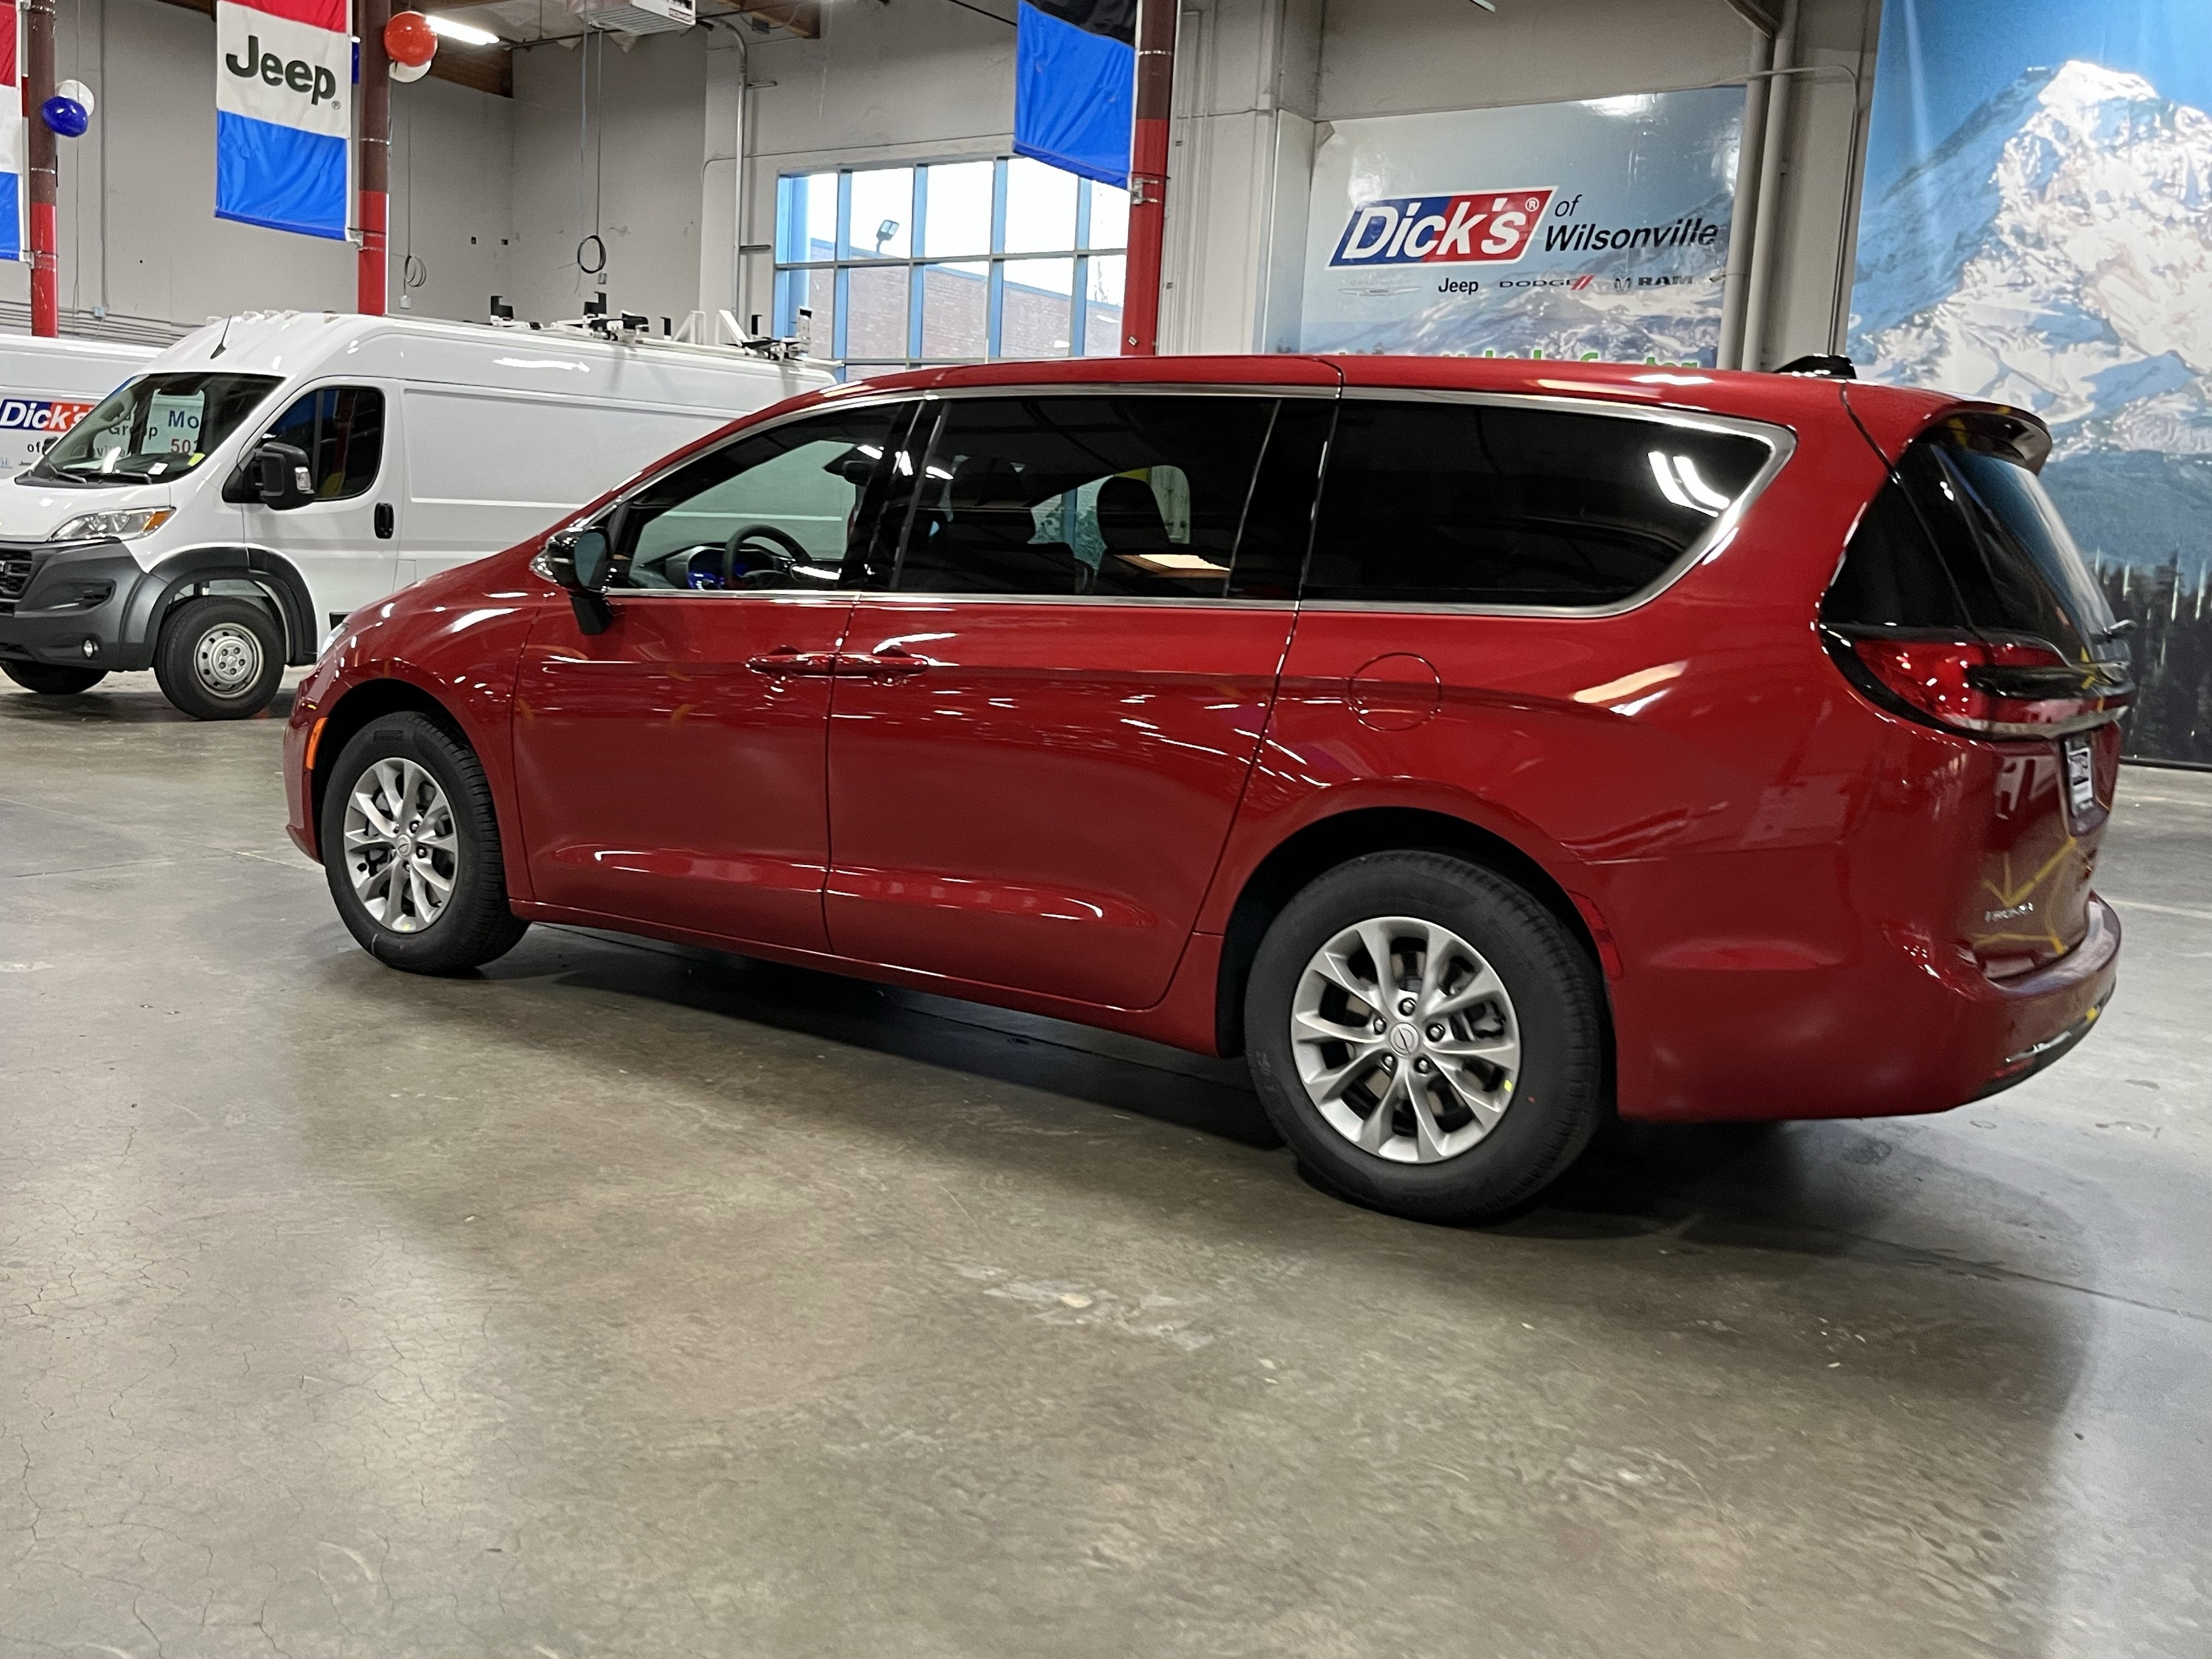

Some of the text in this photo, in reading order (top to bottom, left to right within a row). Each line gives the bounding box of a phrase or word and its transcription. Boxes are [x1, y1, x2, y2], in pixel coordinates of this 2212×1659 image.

[225, 35, 336, 106] Jeep
[1341, 194, 1583, 259] Dick's of
[1545, 218, 1718, 252] Wilsonville
[1438, 278, 1479, 295] Jeep
[1638, 276, 1694, 286] RAM
[27, 442, 41, 453] of
